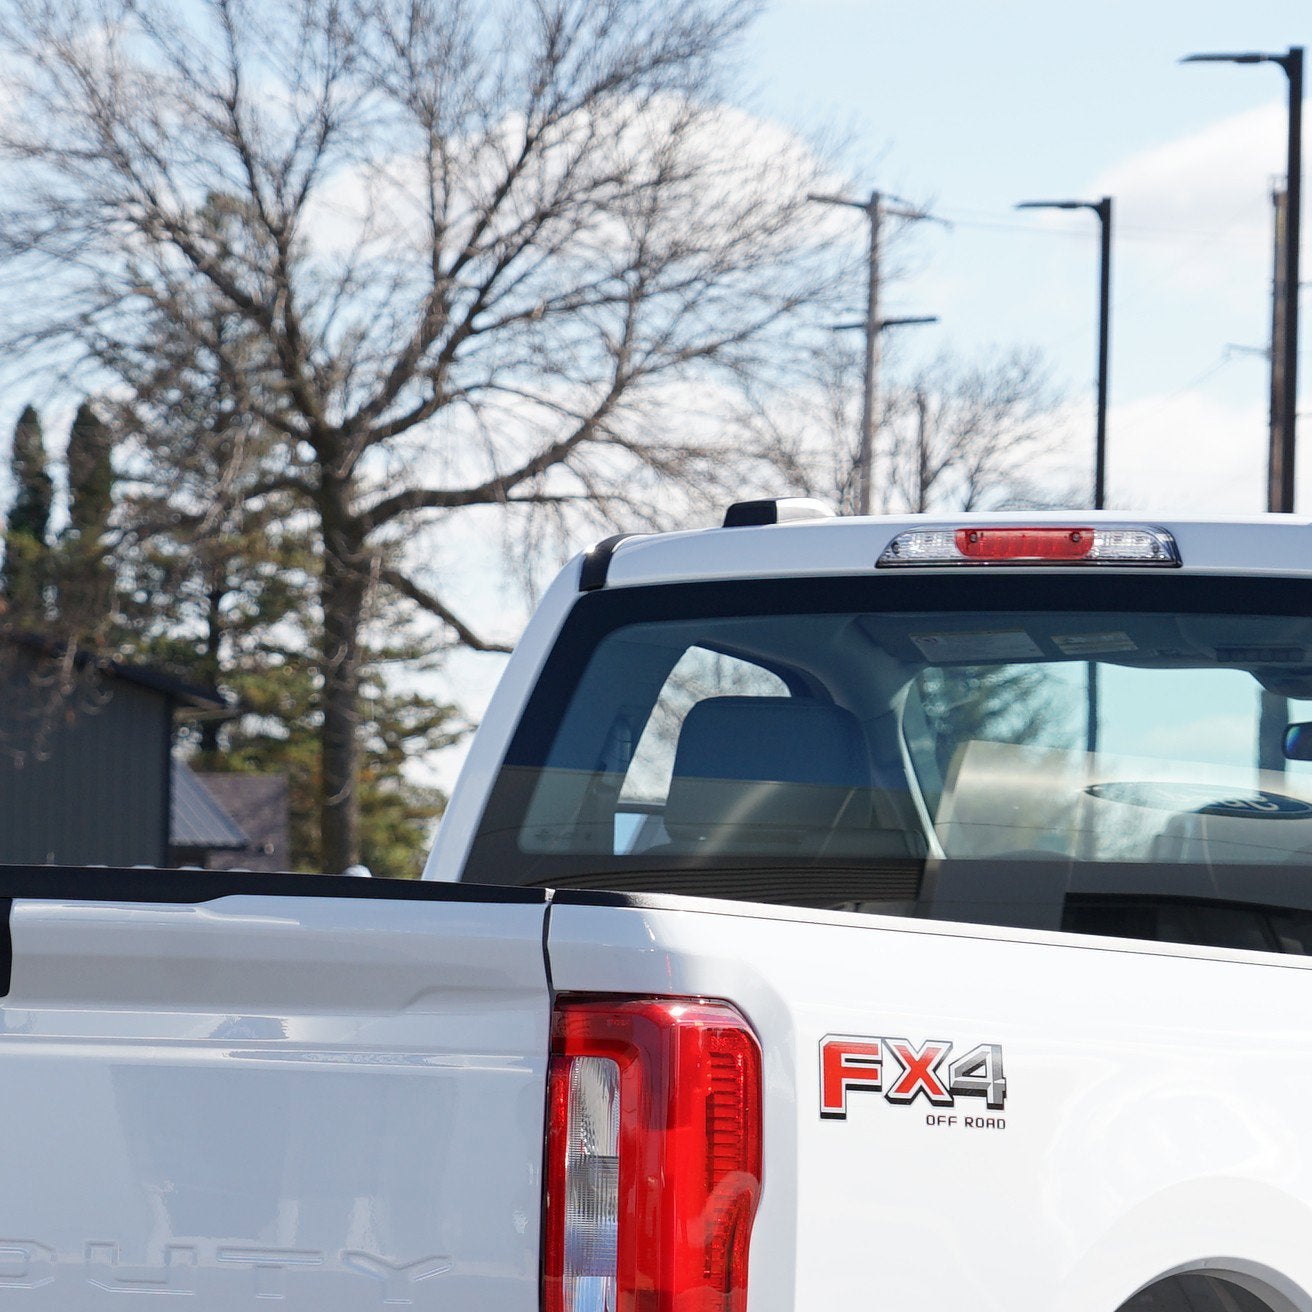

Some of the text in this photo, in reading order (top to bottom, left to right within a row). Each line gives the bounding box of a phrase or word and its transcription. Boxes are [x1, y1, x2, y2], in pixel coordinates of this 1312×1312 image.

[818, 1032, 1007, 1120] FX4
[925, 1114, 1007, 1130] OFF ROAD
